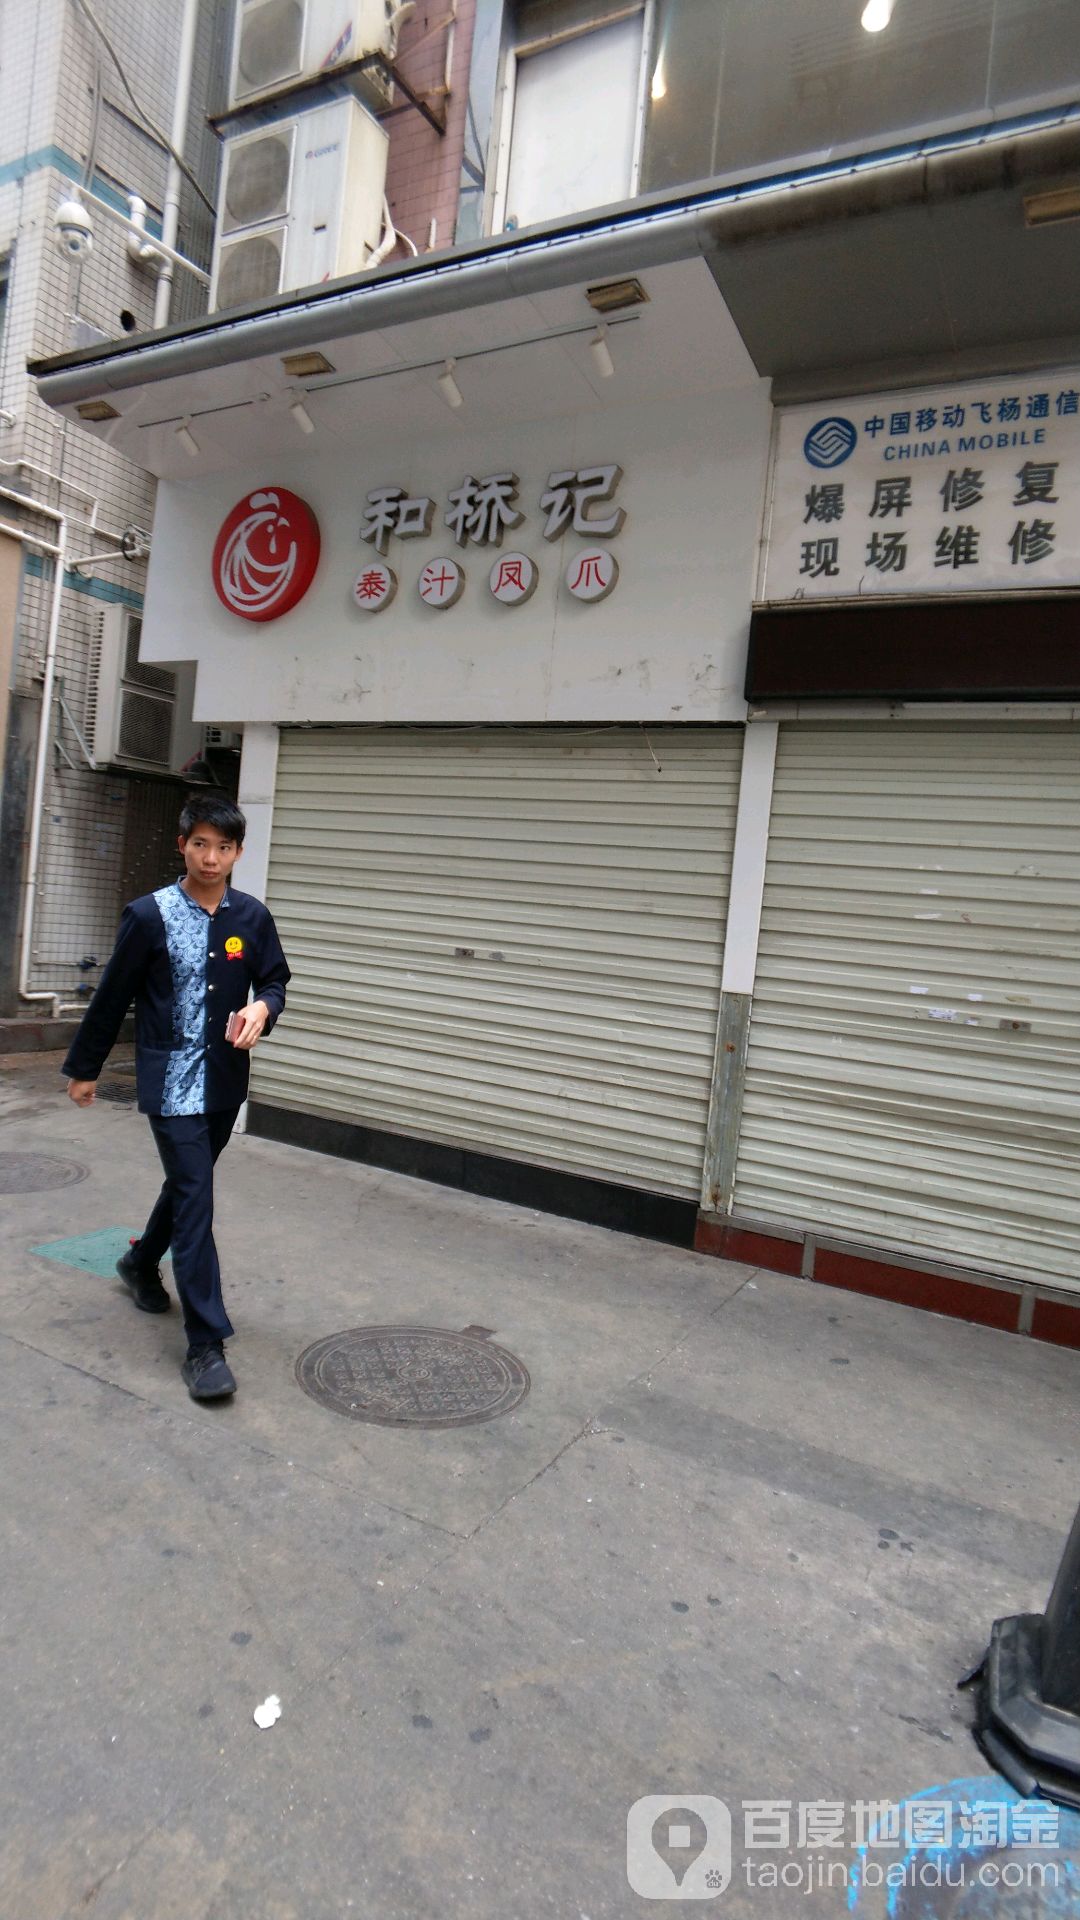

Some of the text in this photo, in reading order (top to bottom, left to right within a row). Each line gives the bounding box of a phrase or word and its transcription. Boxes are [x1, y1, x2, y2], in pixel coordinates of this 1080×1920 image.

[864, 389, 1080, 438] 中国移动飞杨通信
[884, 429, 1046, 461] CHINA MOBILE
[359, 464, 627, 557] 和桥记
[804, 461, 1060, 525] 爆屏修复
[799, 518, 1057, 578] 现场维修
[356, 555, 607, 600] 泰汁凤爪
